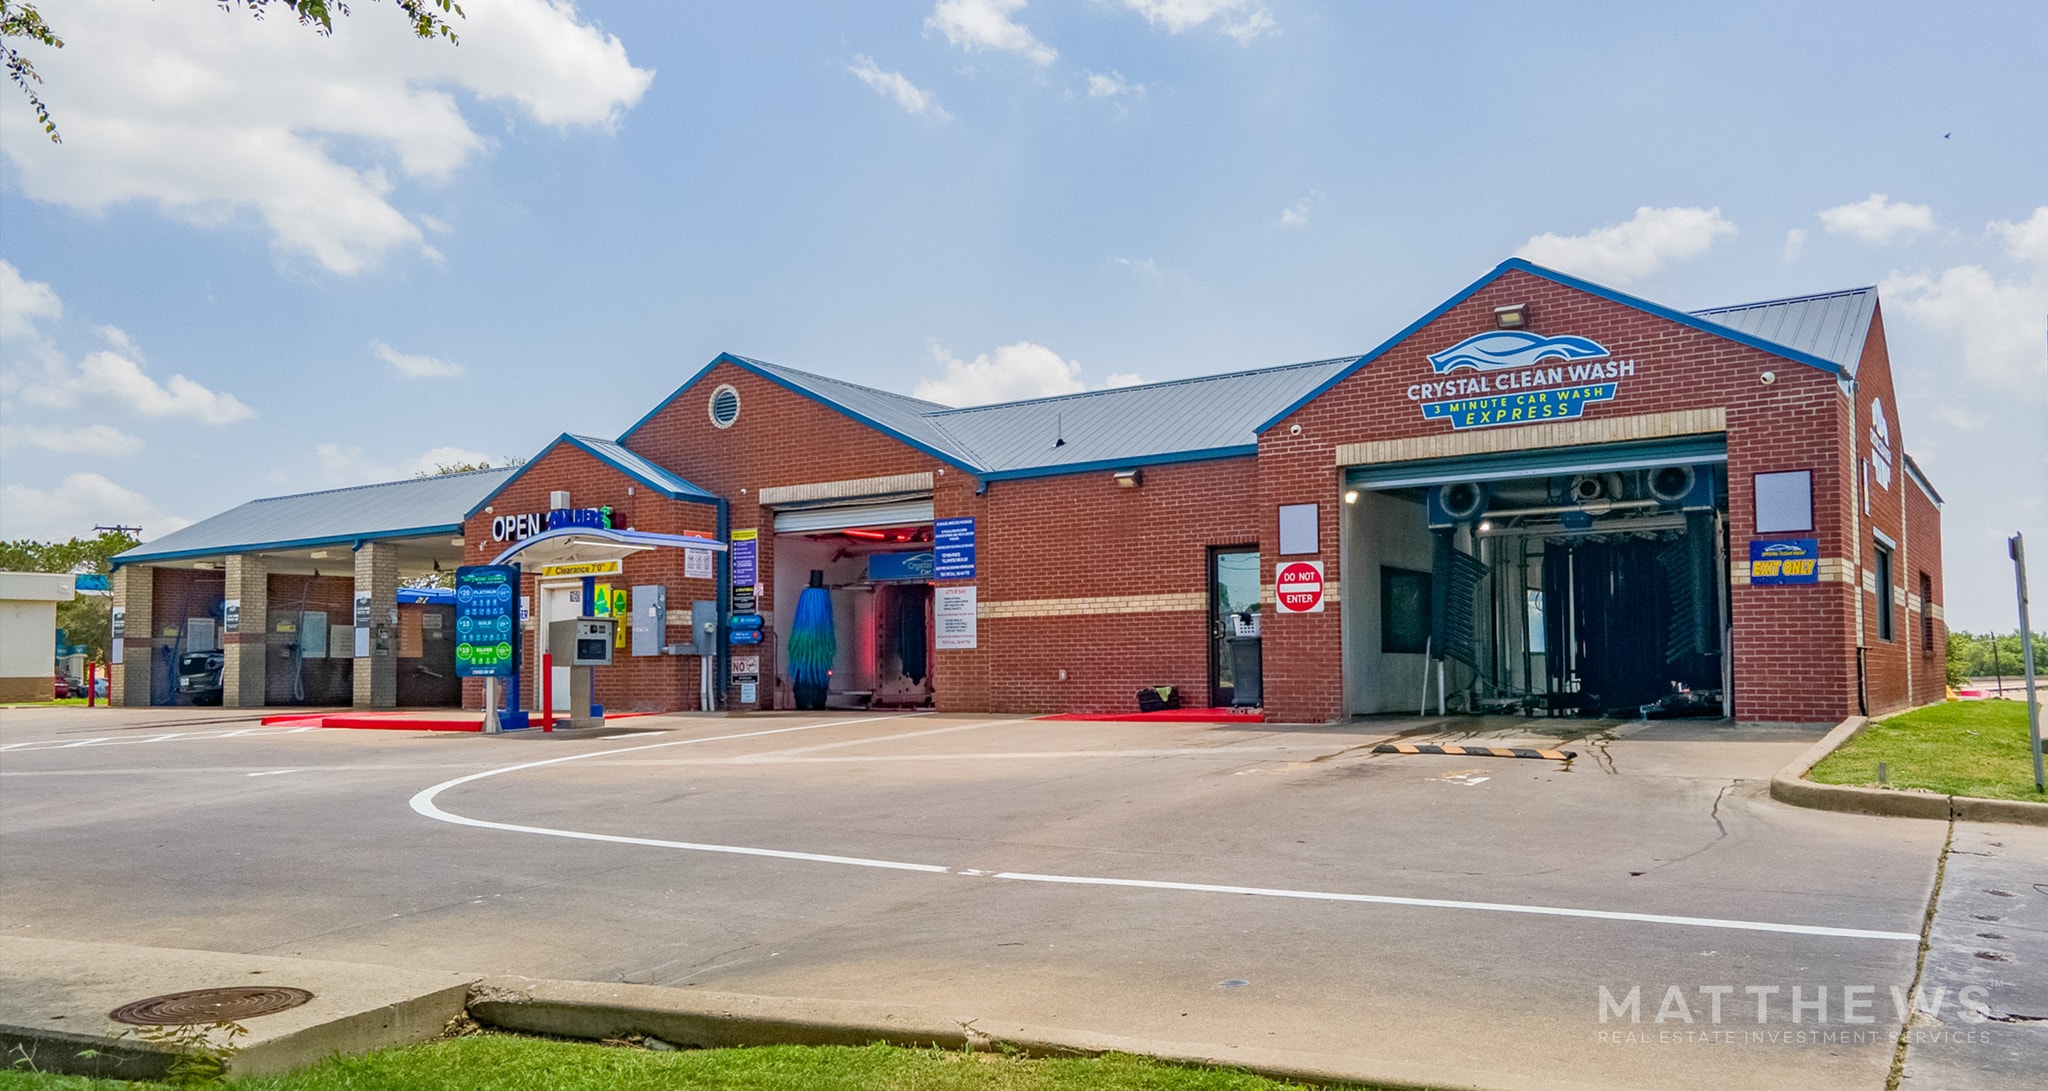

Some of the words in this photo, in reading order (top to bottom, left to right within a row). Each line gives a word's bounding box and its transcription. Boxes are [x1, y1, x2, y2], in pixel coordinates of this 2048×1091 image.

[1407, 378, 1490, 400] CRYSTAL
[1495, 367, 1562, 391] CLEAN
[1568, 359, 1635, 382] WASH
[1434, 405, 1441, 414] 3
[1450, 398, 1507, 412] MINUTE
[1516, 393, 1547, 405] CAR
[1557, 387, 1603, 400] WASH
[1466, 403, 1569, 425] EXPRESS
[492, 513, 540, 542] OPEN
[555, 565, 590, 575] Clearance
[1284, 572, 1296, 582] DO
[1298, 571, 1315, 581] NOT
[1752, 560, 1781, 577] EXIT
[1782, 559, 1816, 576] ONLY
[1286, 594, 1313, 604] ENTER
[733, 662, 745, 672] NO
